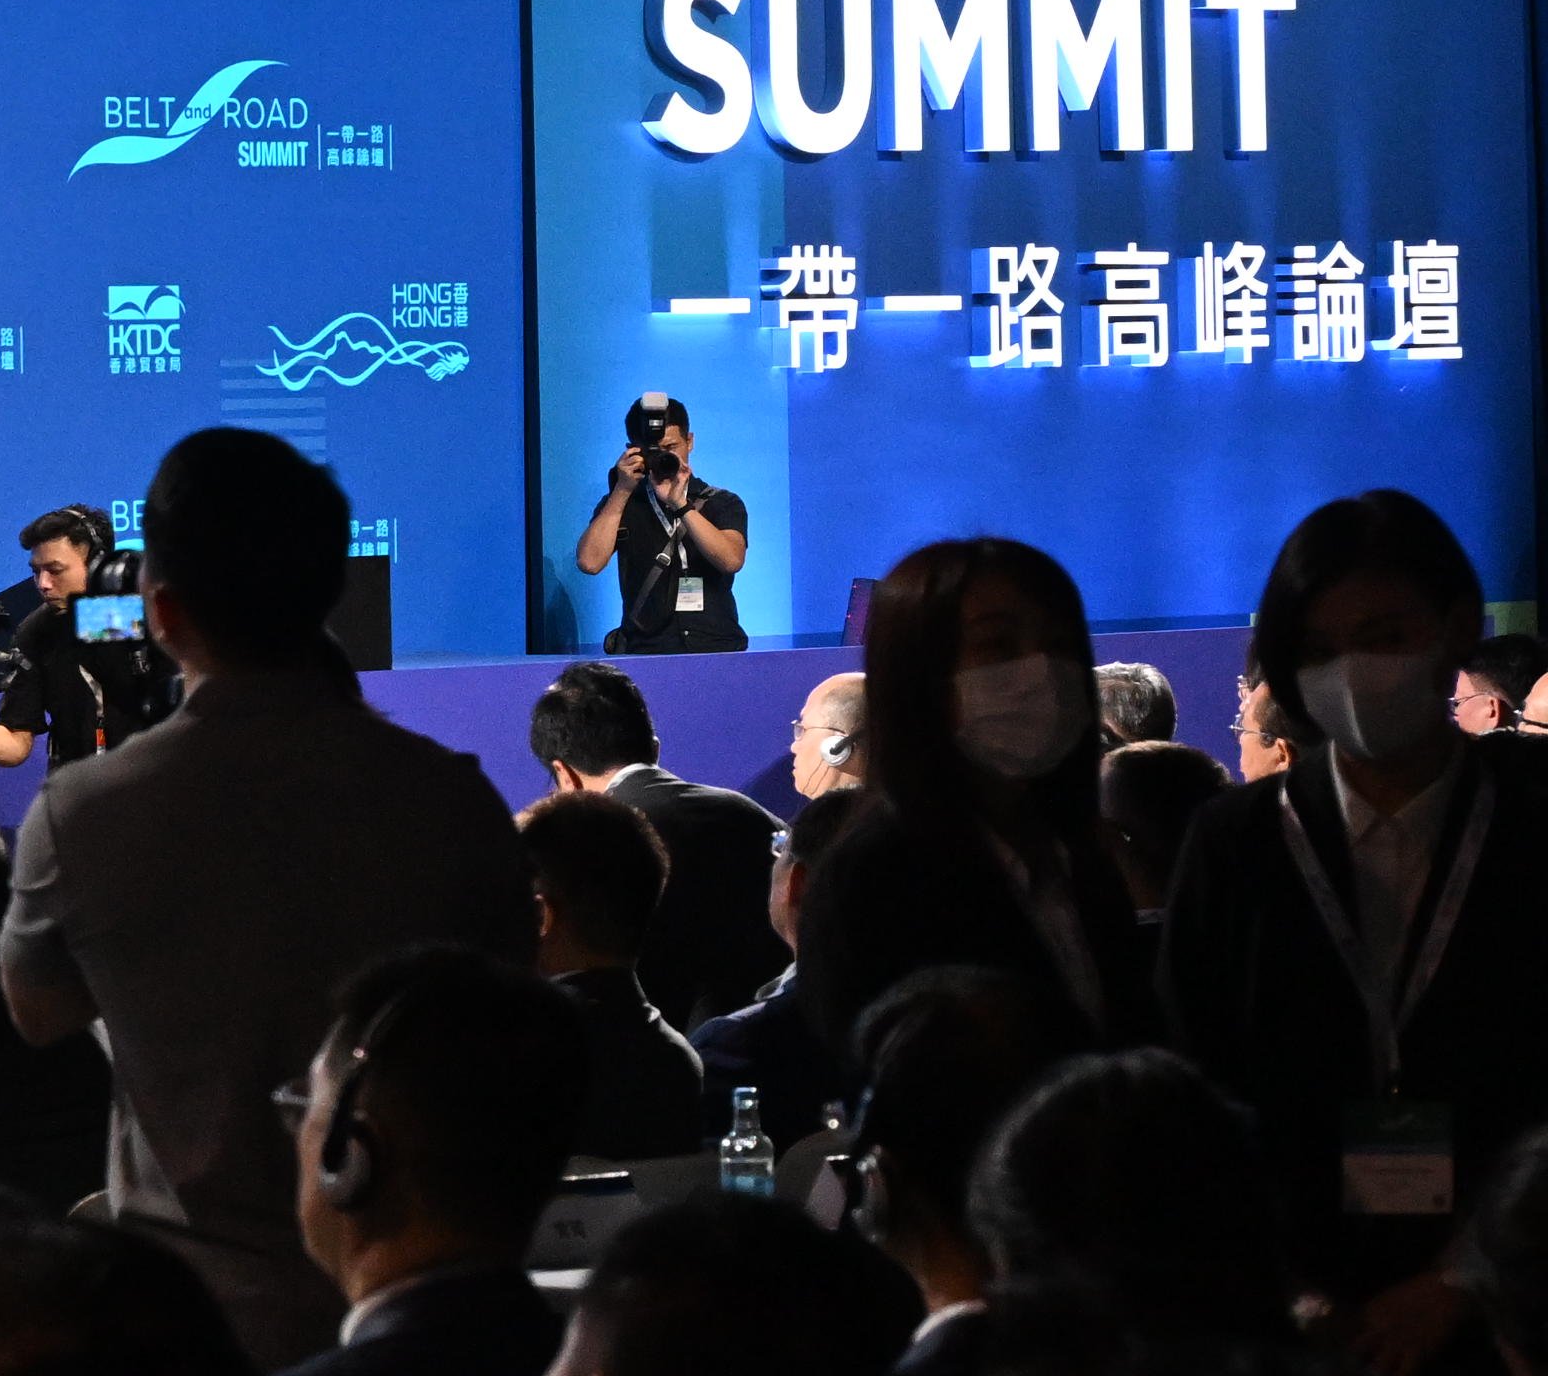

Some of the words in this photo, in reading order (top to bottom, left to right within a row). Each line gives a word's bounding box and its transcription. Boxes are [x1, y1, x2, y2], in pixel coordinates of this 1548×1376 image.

[104, 96, 174, 129] BELT
[183, 100, 212, 120] and
[223, 97, 308, 128] ROAD
[327, 125, 383, 143] 一帶一路
[239, 141, 308, 166] SUMMIT
[671, 240, 1462, 372] 一帶一路高峰論壇
[109, 324, 180, 355] HKTDC
